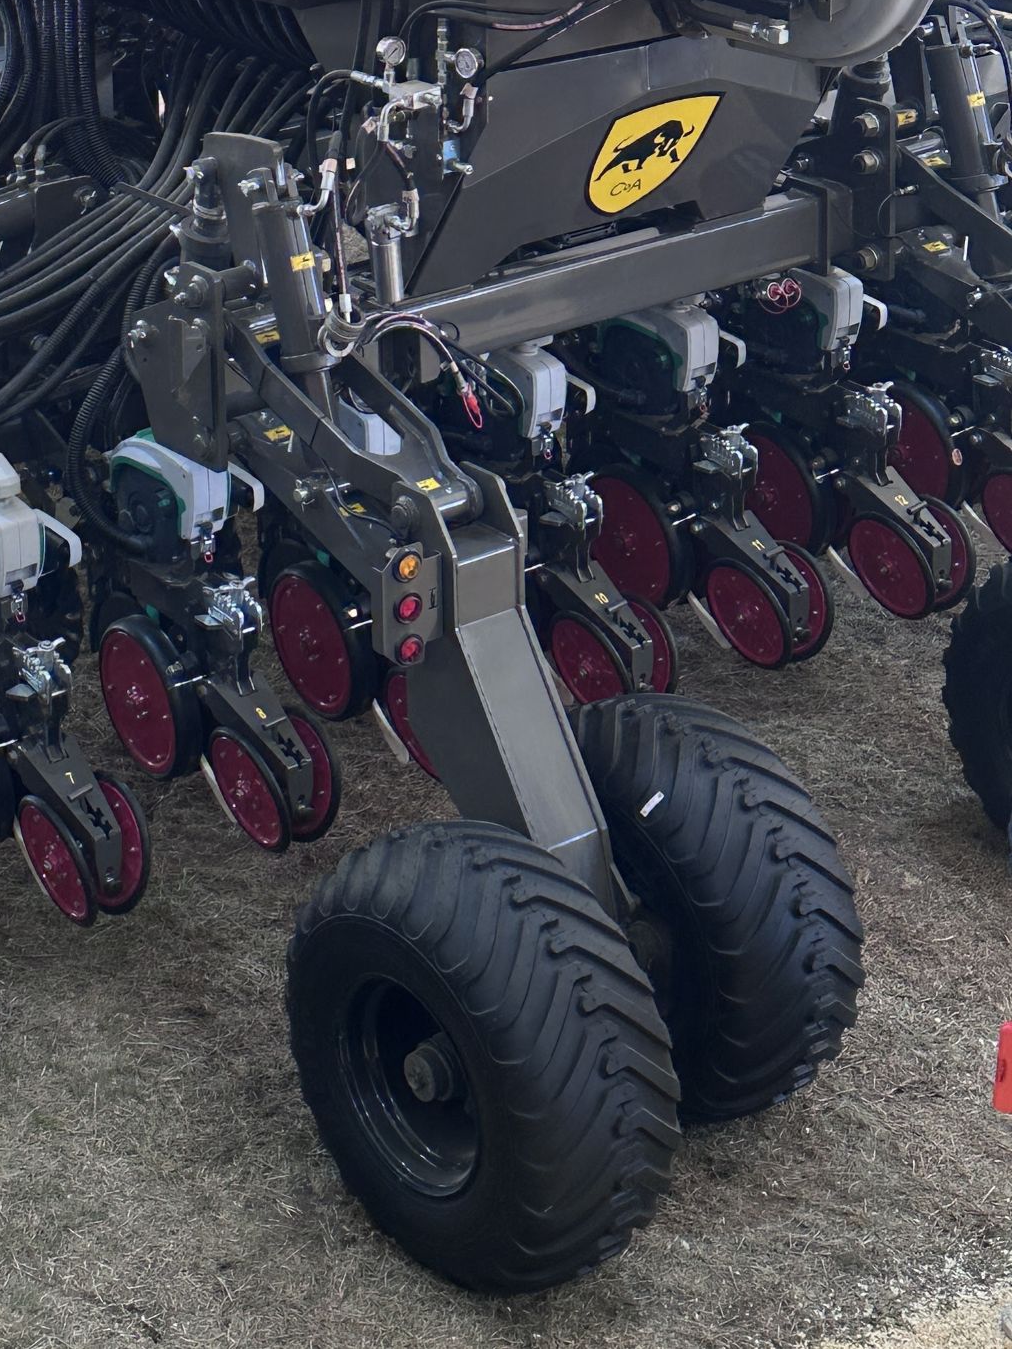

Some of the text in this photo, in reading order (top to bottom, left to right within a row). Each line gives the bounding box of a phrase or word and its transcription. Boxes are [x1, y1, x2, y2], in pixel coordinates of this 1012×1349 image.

[594, 592, 609, 605] 10
[255, 707, 267, 719] 8
[64, 771, 75, 785] 7
